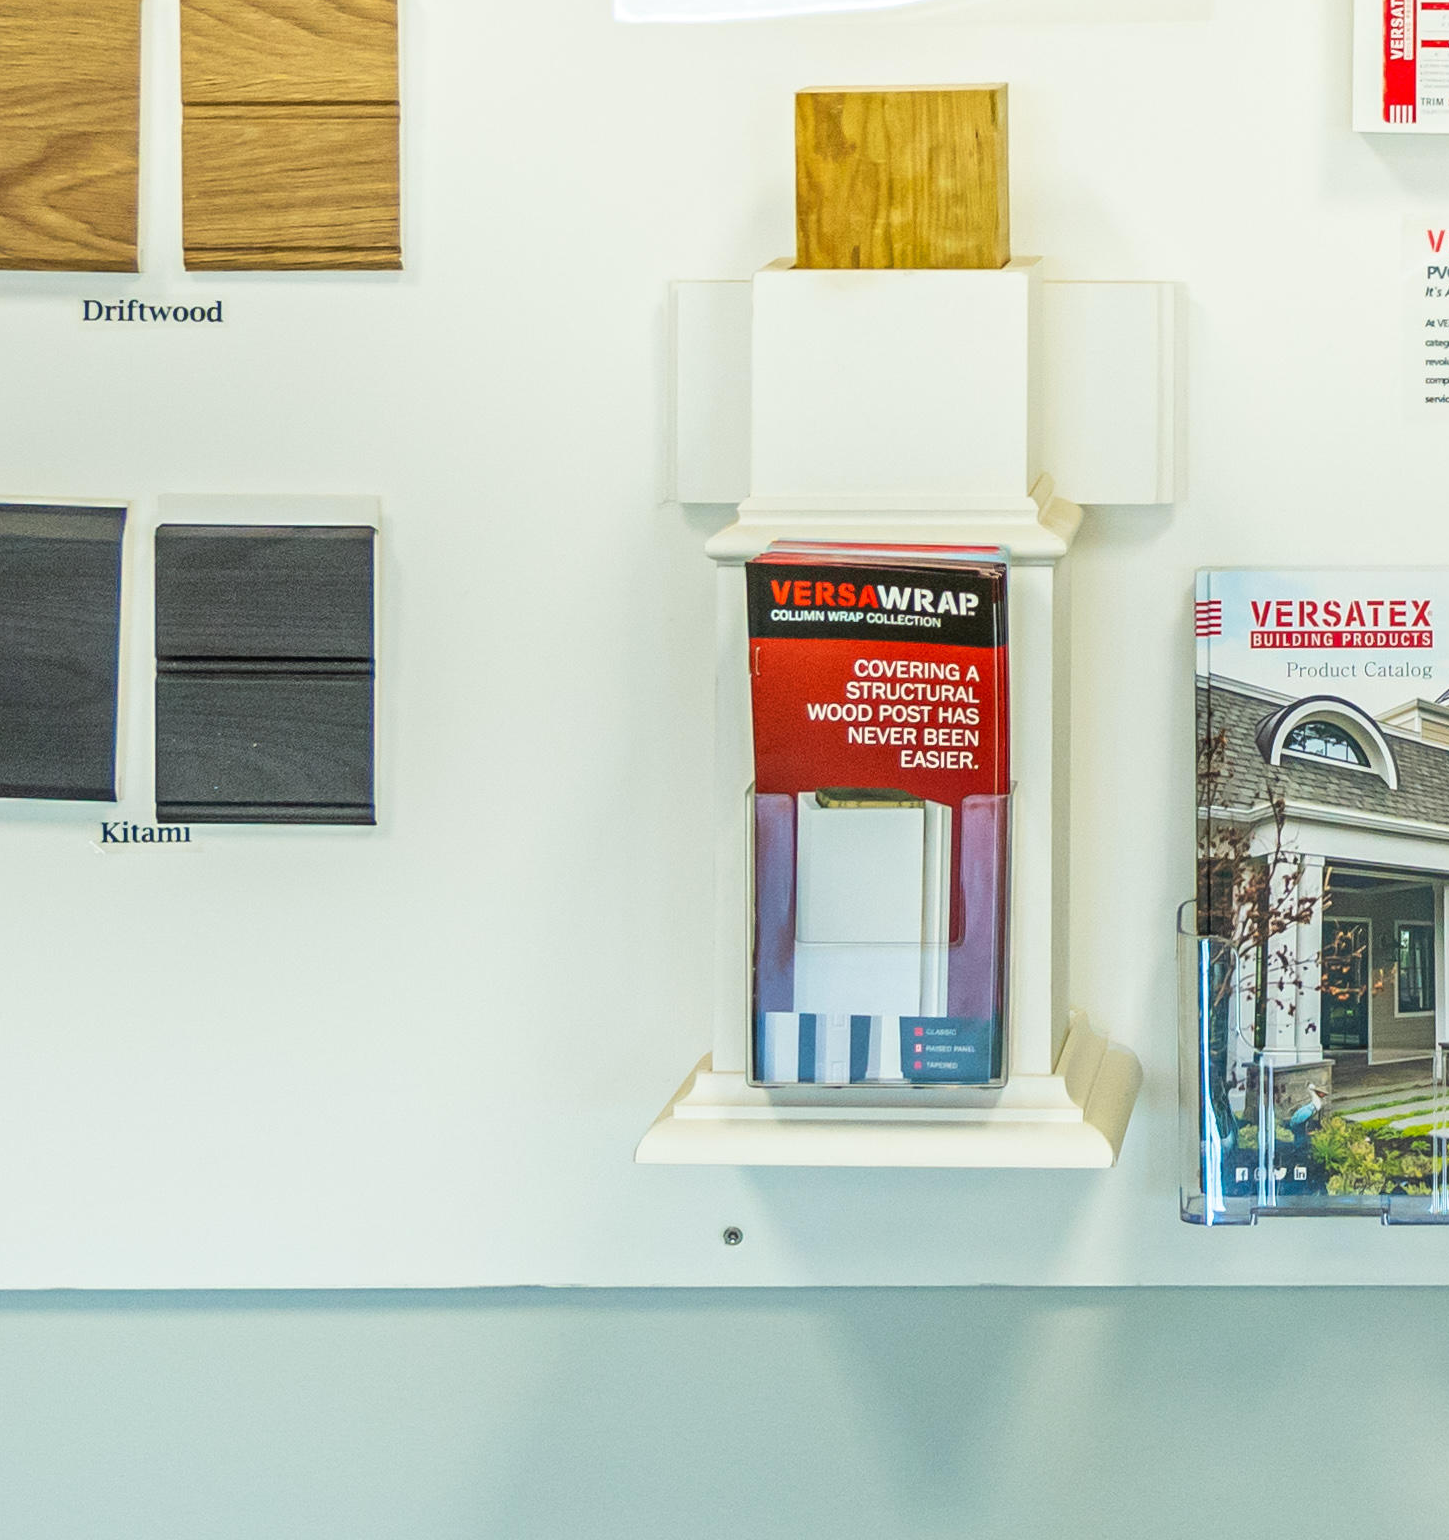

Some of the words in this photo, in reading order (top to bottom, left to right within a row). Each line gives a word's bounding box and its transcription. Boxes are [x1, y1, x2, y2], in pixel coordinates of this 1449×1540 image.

[1421, 98, 1444, 106] TRIM
[1425, 286, 1442, 298] It's
[83, 300, 222, 322] Driftwood
[771, 579, 979, 617] VERSAWRAP
[771, 609, 824, 623] COLUMN
[827, 611, 864, 625] WRAP
[867, 614, 941, 628] COLLECTION
[1251, 600, 1431, 627] VERSATEX
[1253, 633, 1334, 646] BUILDING
[1343, 633, 1431, 646] PRODUCTS
[854, 659, 960, 682] COVERING
[965, 660, 979, 683] A
[1287, 662, 1356, 678] Product
[1365, 662, 1433, 679] Catalog
[846, 681, 979, 704] STRUCTURAL
[807, 703, 872, 723] WOOD
[878, 705, 932, 724] POST
[937, 706, 979, 726] HAS
[847, 726, 916, 746] NEVER
[923, 727, 979, 747] BEEN
[900, 750, 979, 770] EASIER.
[101, 821, 192, 844] Kitami
